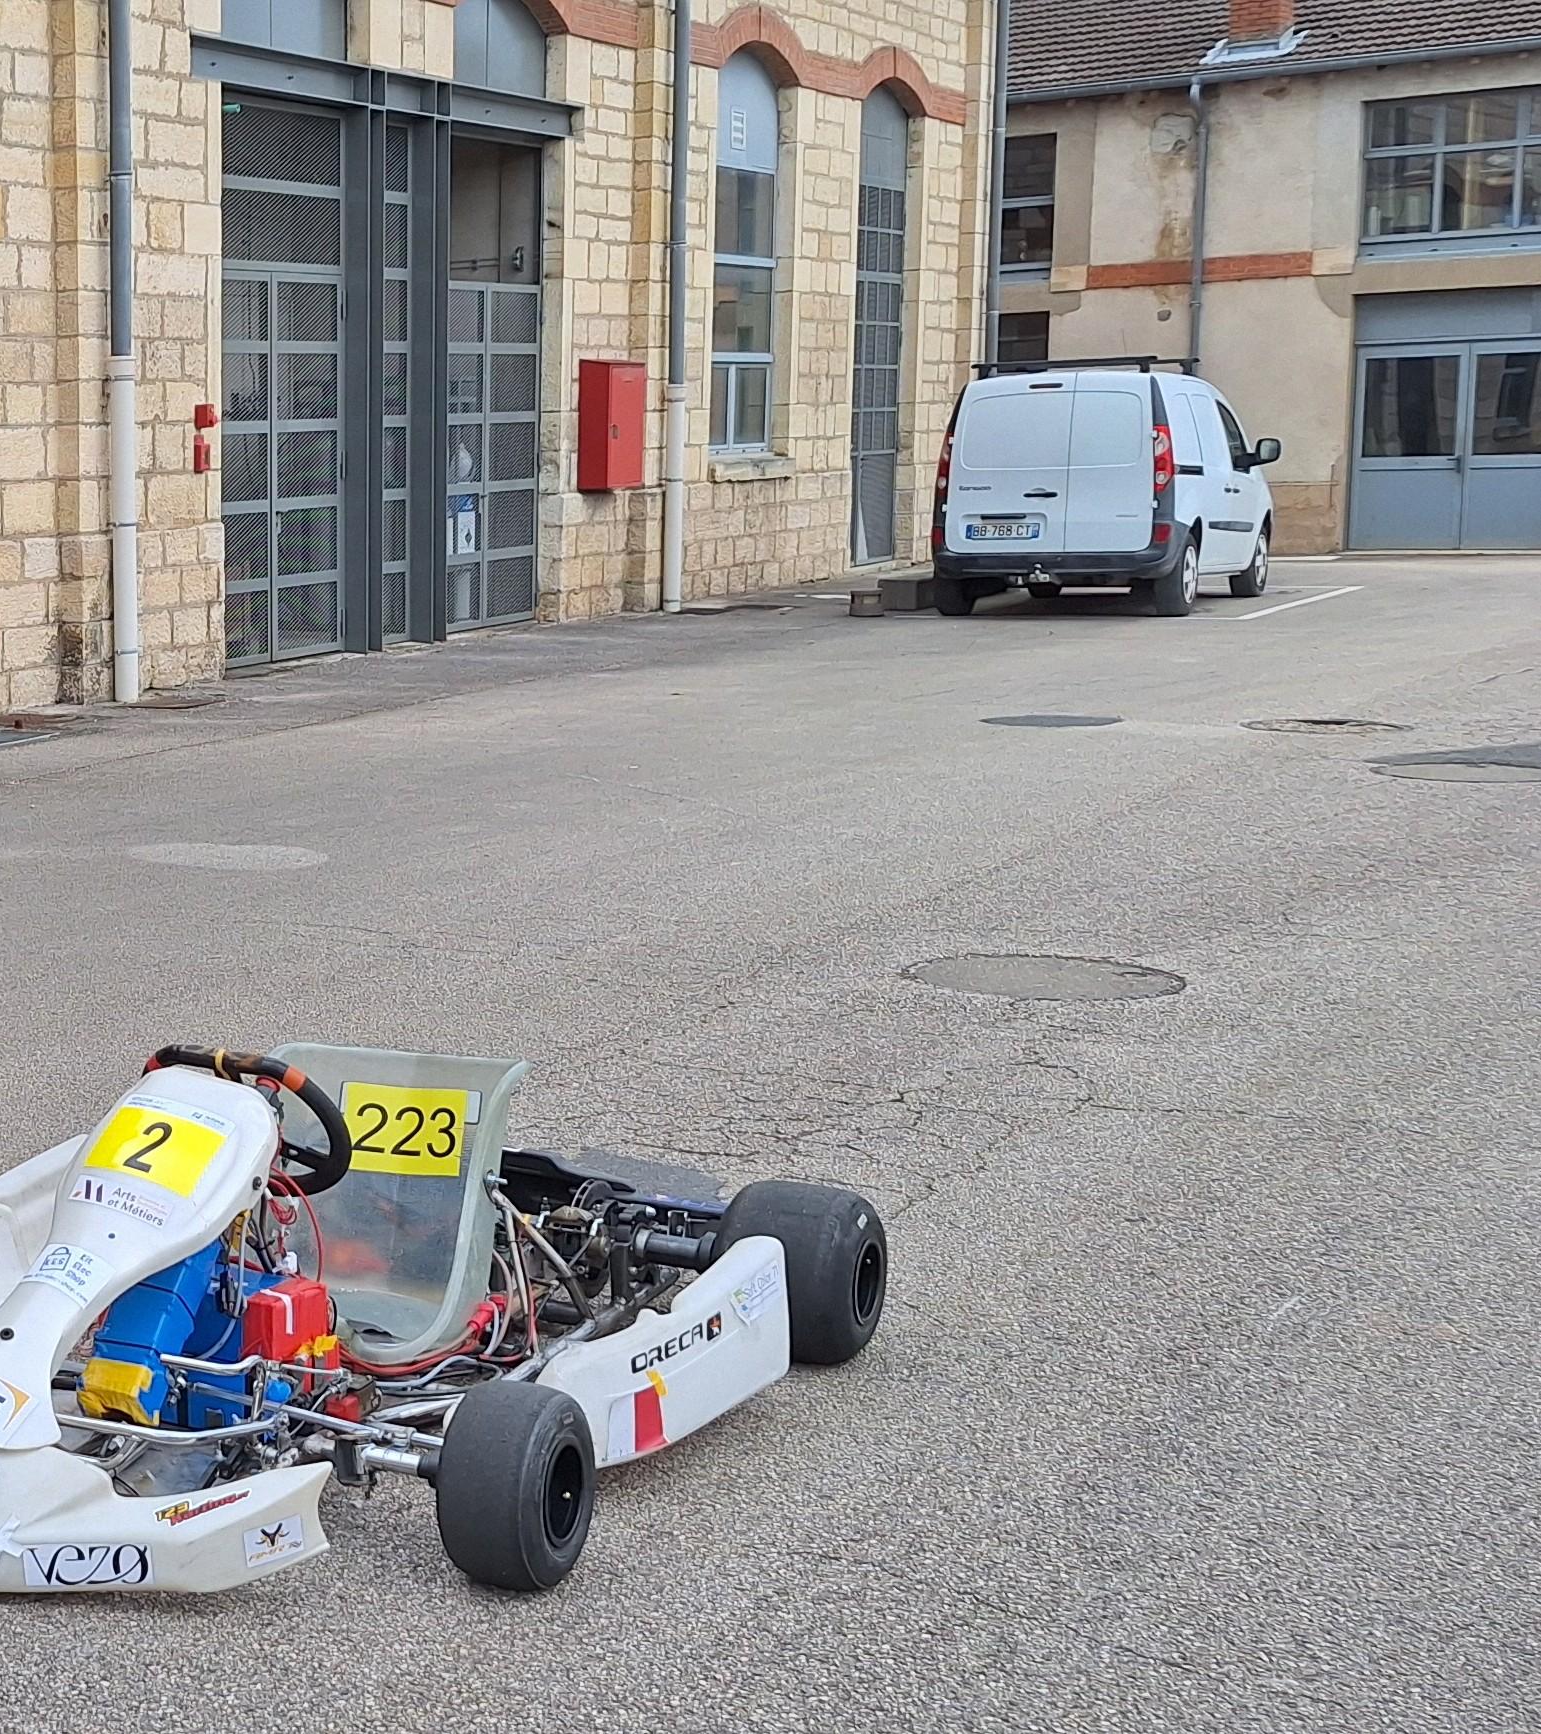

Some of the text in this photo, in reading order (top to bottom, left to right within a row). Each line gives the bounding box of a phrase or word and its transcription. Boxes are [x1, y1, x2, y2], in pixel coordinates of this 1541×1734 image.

[122, 1121, 173, 1174] 2
[352, 1102, 456, 1158] 223
[107, 1198, 119, 1208] et
[120, 1200, 165, 1227] Métiers
[111, 1187, 137, 1203] Arts
[630, 1322, 703, 1374] ORECA
